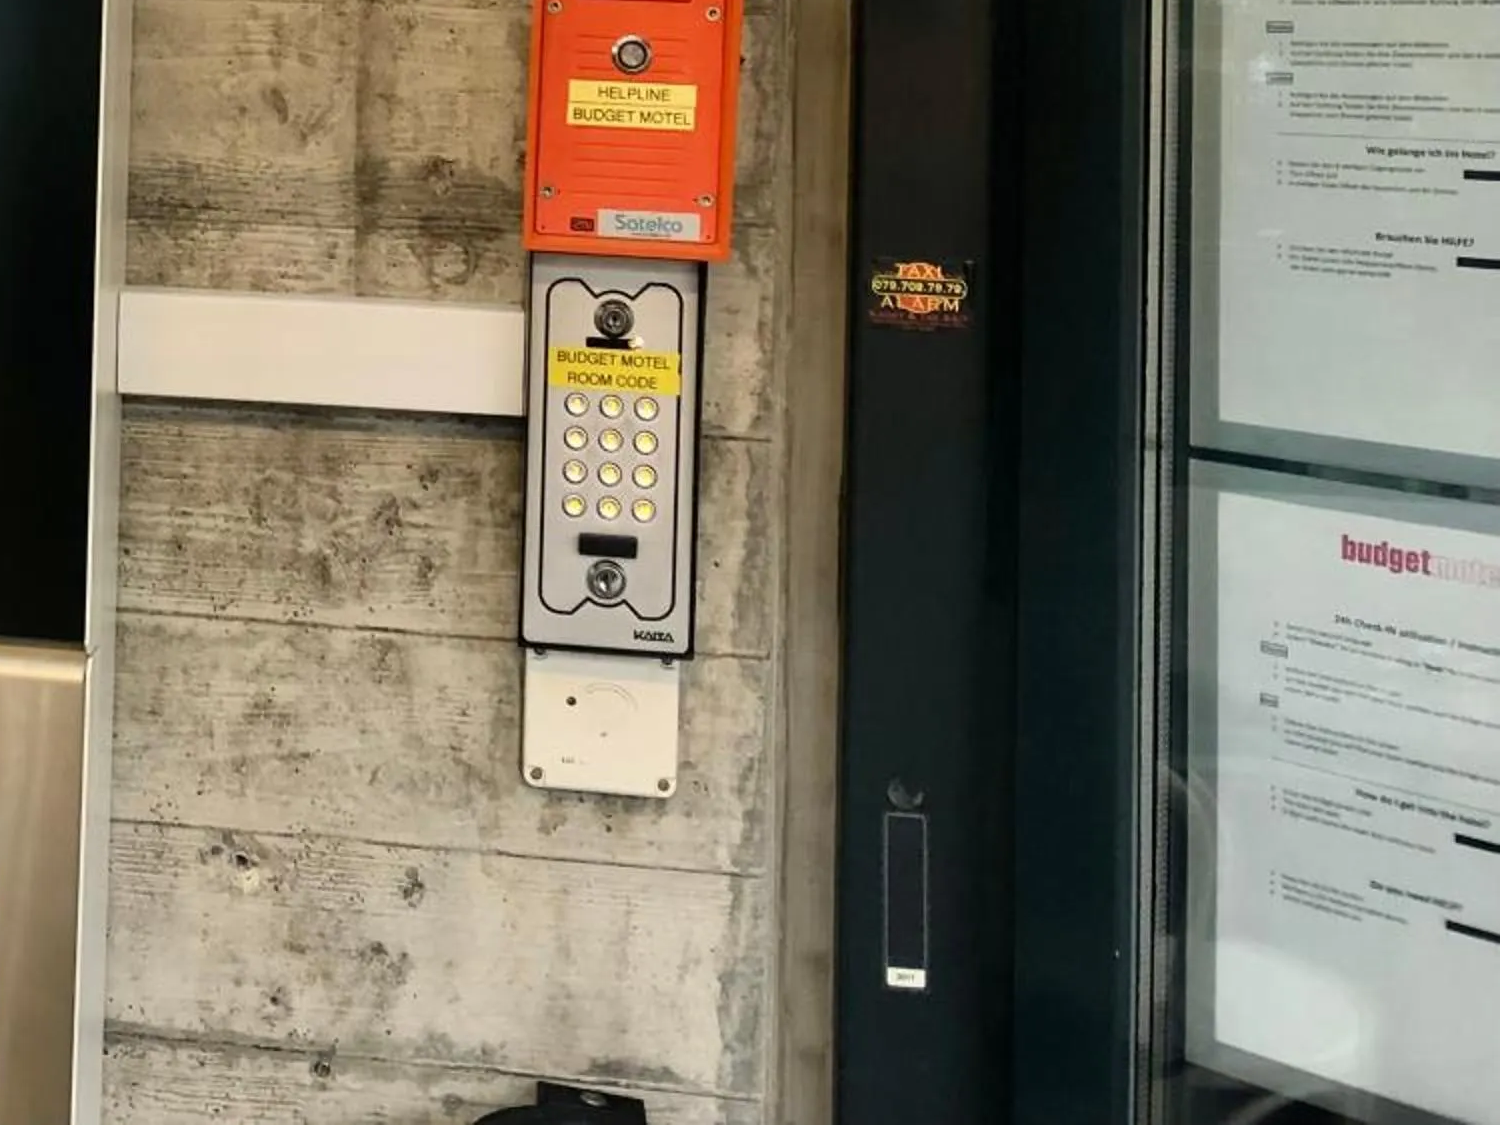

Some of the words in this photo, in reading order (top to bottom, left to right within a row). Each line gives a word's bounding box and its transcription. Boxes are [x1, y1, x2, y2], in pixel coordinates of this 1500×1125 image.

[597, 86, 672, 102] HELPLINE
[573, 107, 637, 122] BUDGET
[639, 111, 691, 126] MOTEL
[895, 261, 943, 279] TAXI
[880, 294, 960, 313] ALARM
[557, 350, 618, 366] BUDGET
[621, 354, 671, 370] MOTEL
[567, 371, 612, 386] ROOM
[615, 375, 658, 390] CODE
